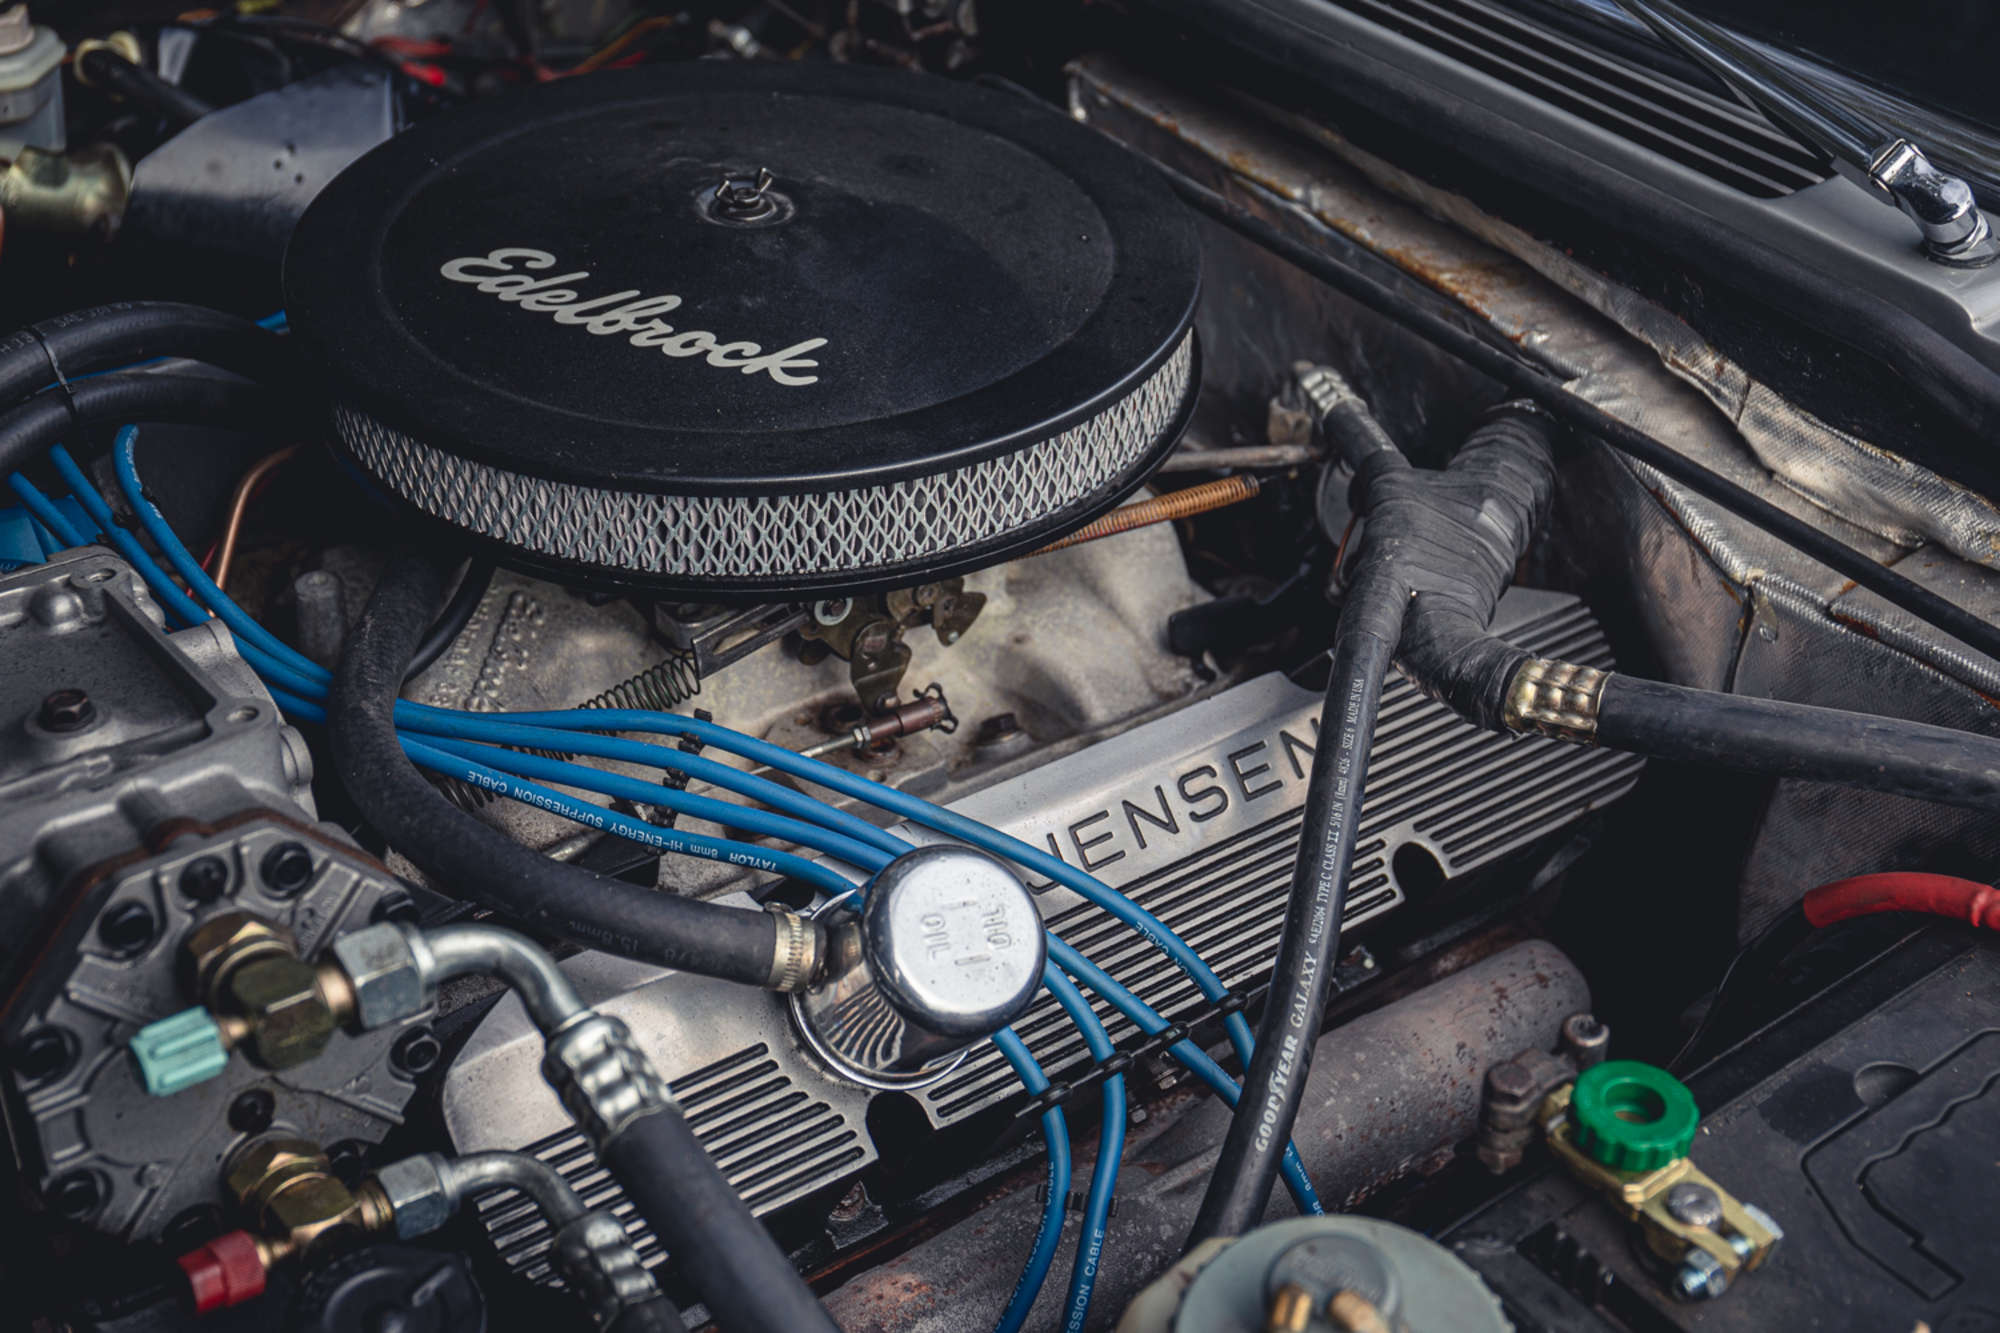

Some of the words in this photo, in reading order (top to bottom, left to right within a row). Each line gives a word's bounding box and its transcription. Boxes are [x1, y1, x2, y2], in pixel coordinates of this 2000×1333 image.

[441, 247, 828, 386] Edelbrock
[1351, 679, 1365, 694] USA
[1345, 702, 1359, 725] MADE
[1342, 733, 1354, 750] SIZE
[467, 770, 508, 793] CABLE
[513, 786, 604, 828] SUPPRESSION
[609, 821, 684, 852] HI-ENERGY
[690, 843, 719, 858] 8mm
[729, 851, 777, 872] TAYLOR
[1322, 843, 1337, 870] CLASS
[1320, 872, 1332, 880] C
[1316, 880, 1331, 903] TYPE
[920, 911, 951, 960] OIL
[1291, 952, 1317, 1028] GALAXY
[1256, 1034, 1298, 1154] GOODYEAR
[1084, 1228, 1105, 1277] CABLE
